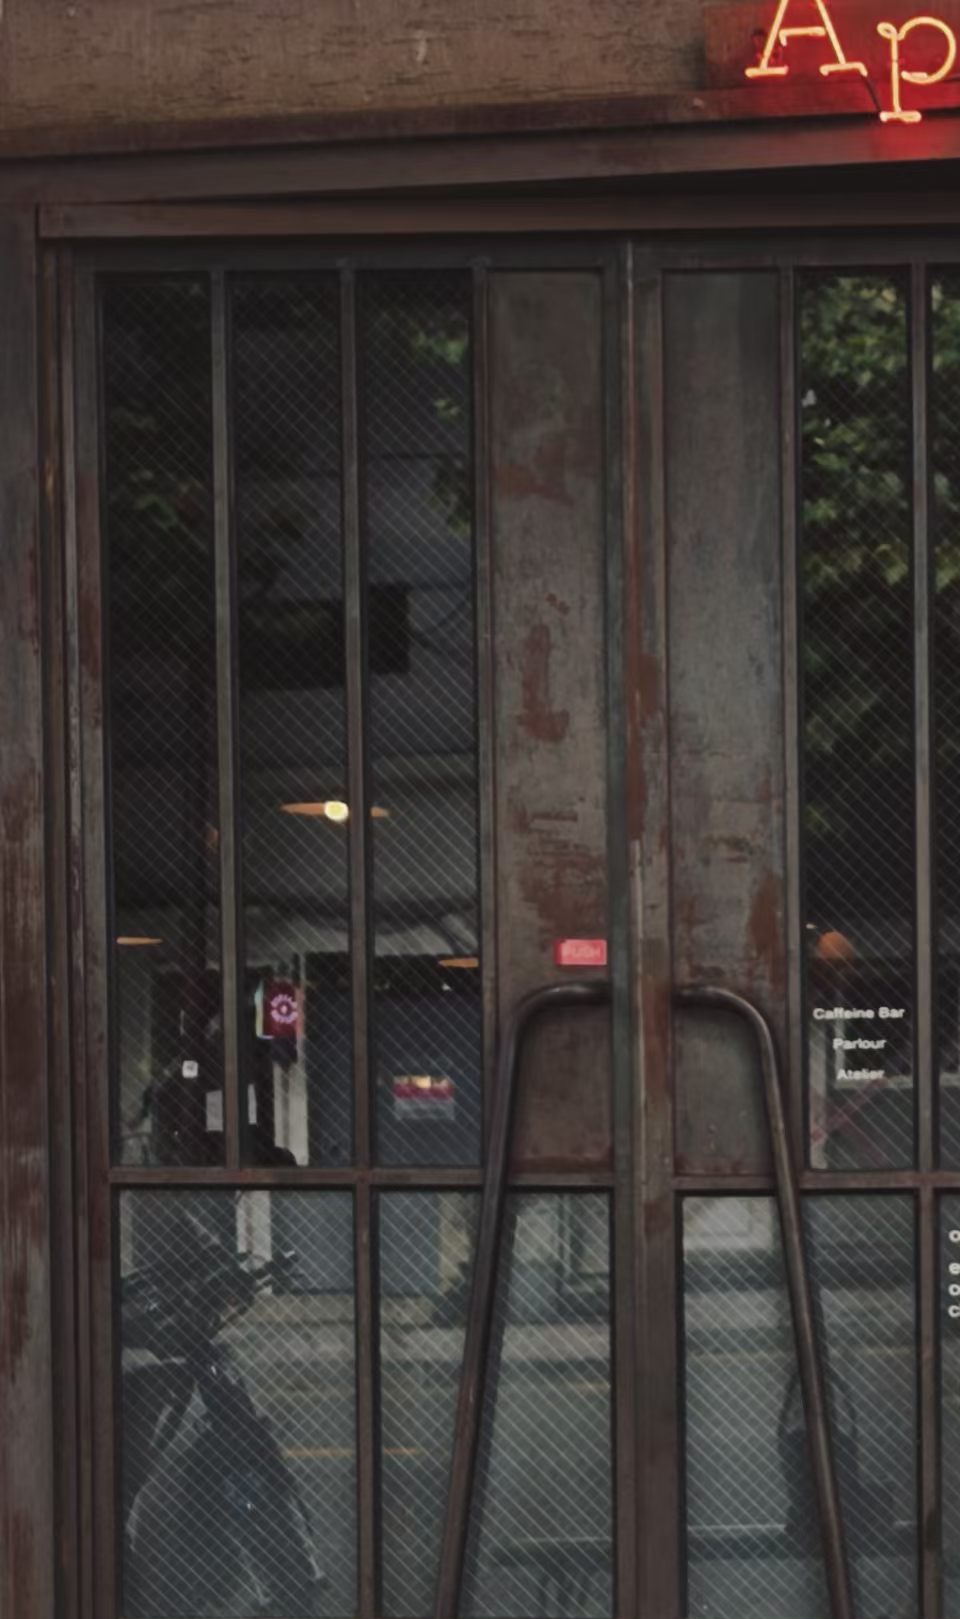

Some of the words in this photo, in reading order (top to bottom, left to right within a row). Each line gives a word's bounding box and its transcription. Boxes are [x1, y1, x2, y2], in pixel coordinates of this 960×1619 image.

[813, 1007, 875, 1020] Caffeine
[878, 1006, 905, 1019] Bar
[833, 1038, 887, 1050] Parlour
[837, 1068, 885, 1081] Atelier
